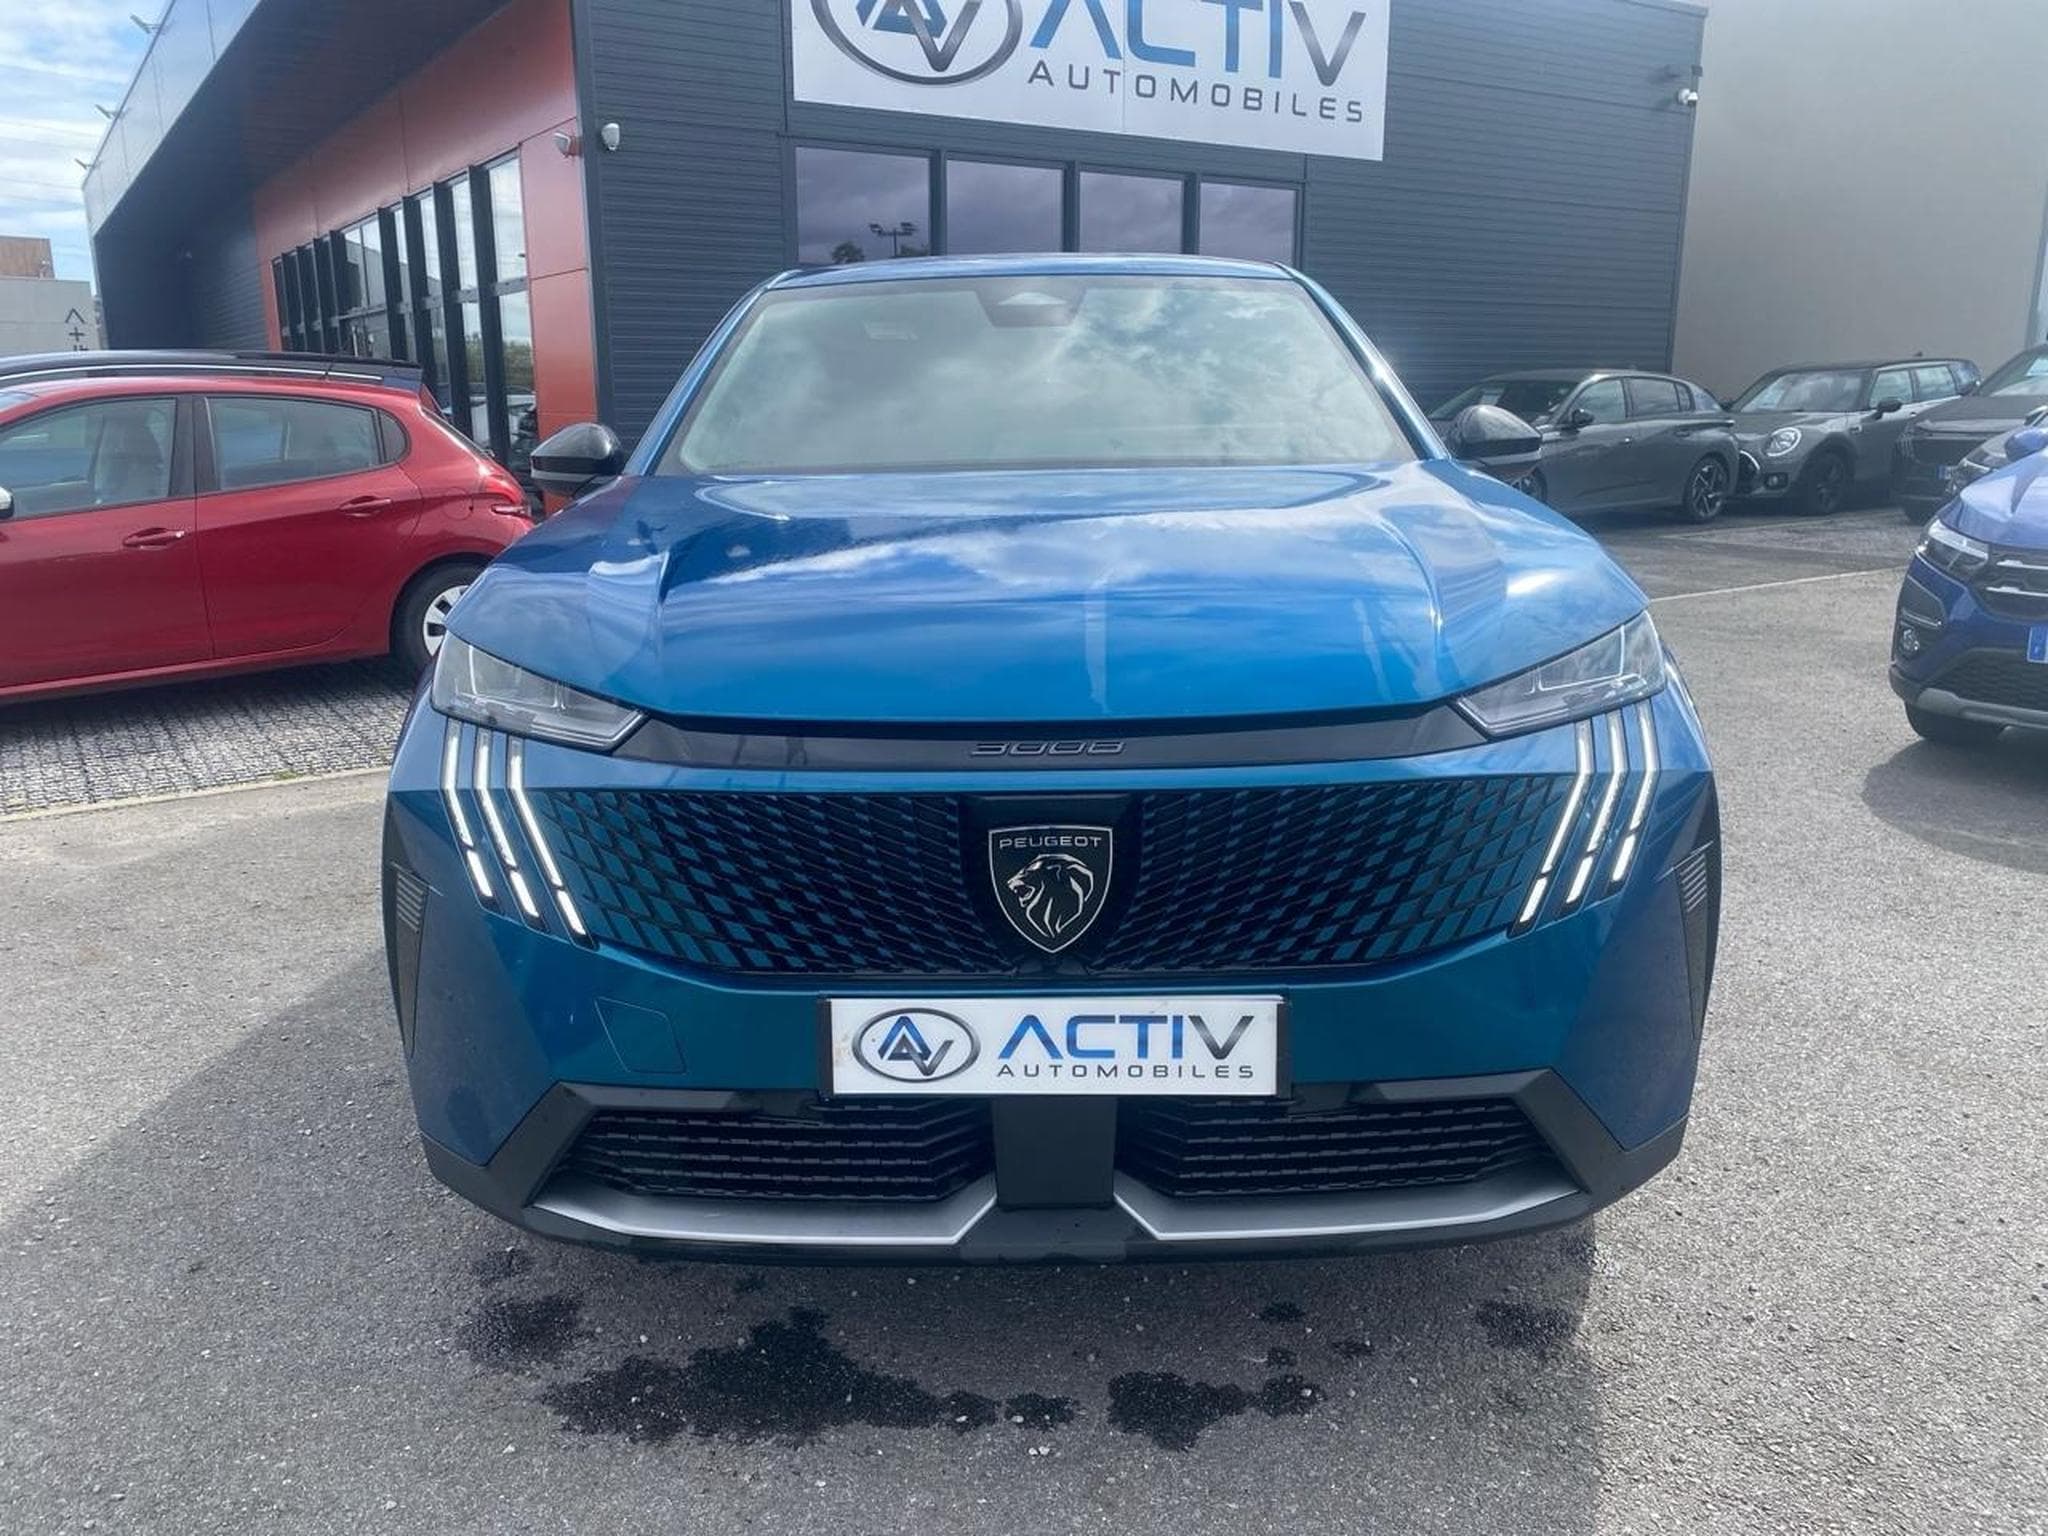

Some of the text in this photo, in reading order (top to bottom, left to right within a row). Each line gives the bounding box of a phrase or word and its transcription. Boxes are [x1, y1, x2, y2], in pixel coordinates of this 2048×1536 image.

[1027, 60, 1362, 123] AUTOMOBILES
[1000, 836, 1102, 849] PEUGEOT
[998, 1014, 1255, 1060] ACTIV
[997, 1064, 1254, 1079] AUTOMOBILES
